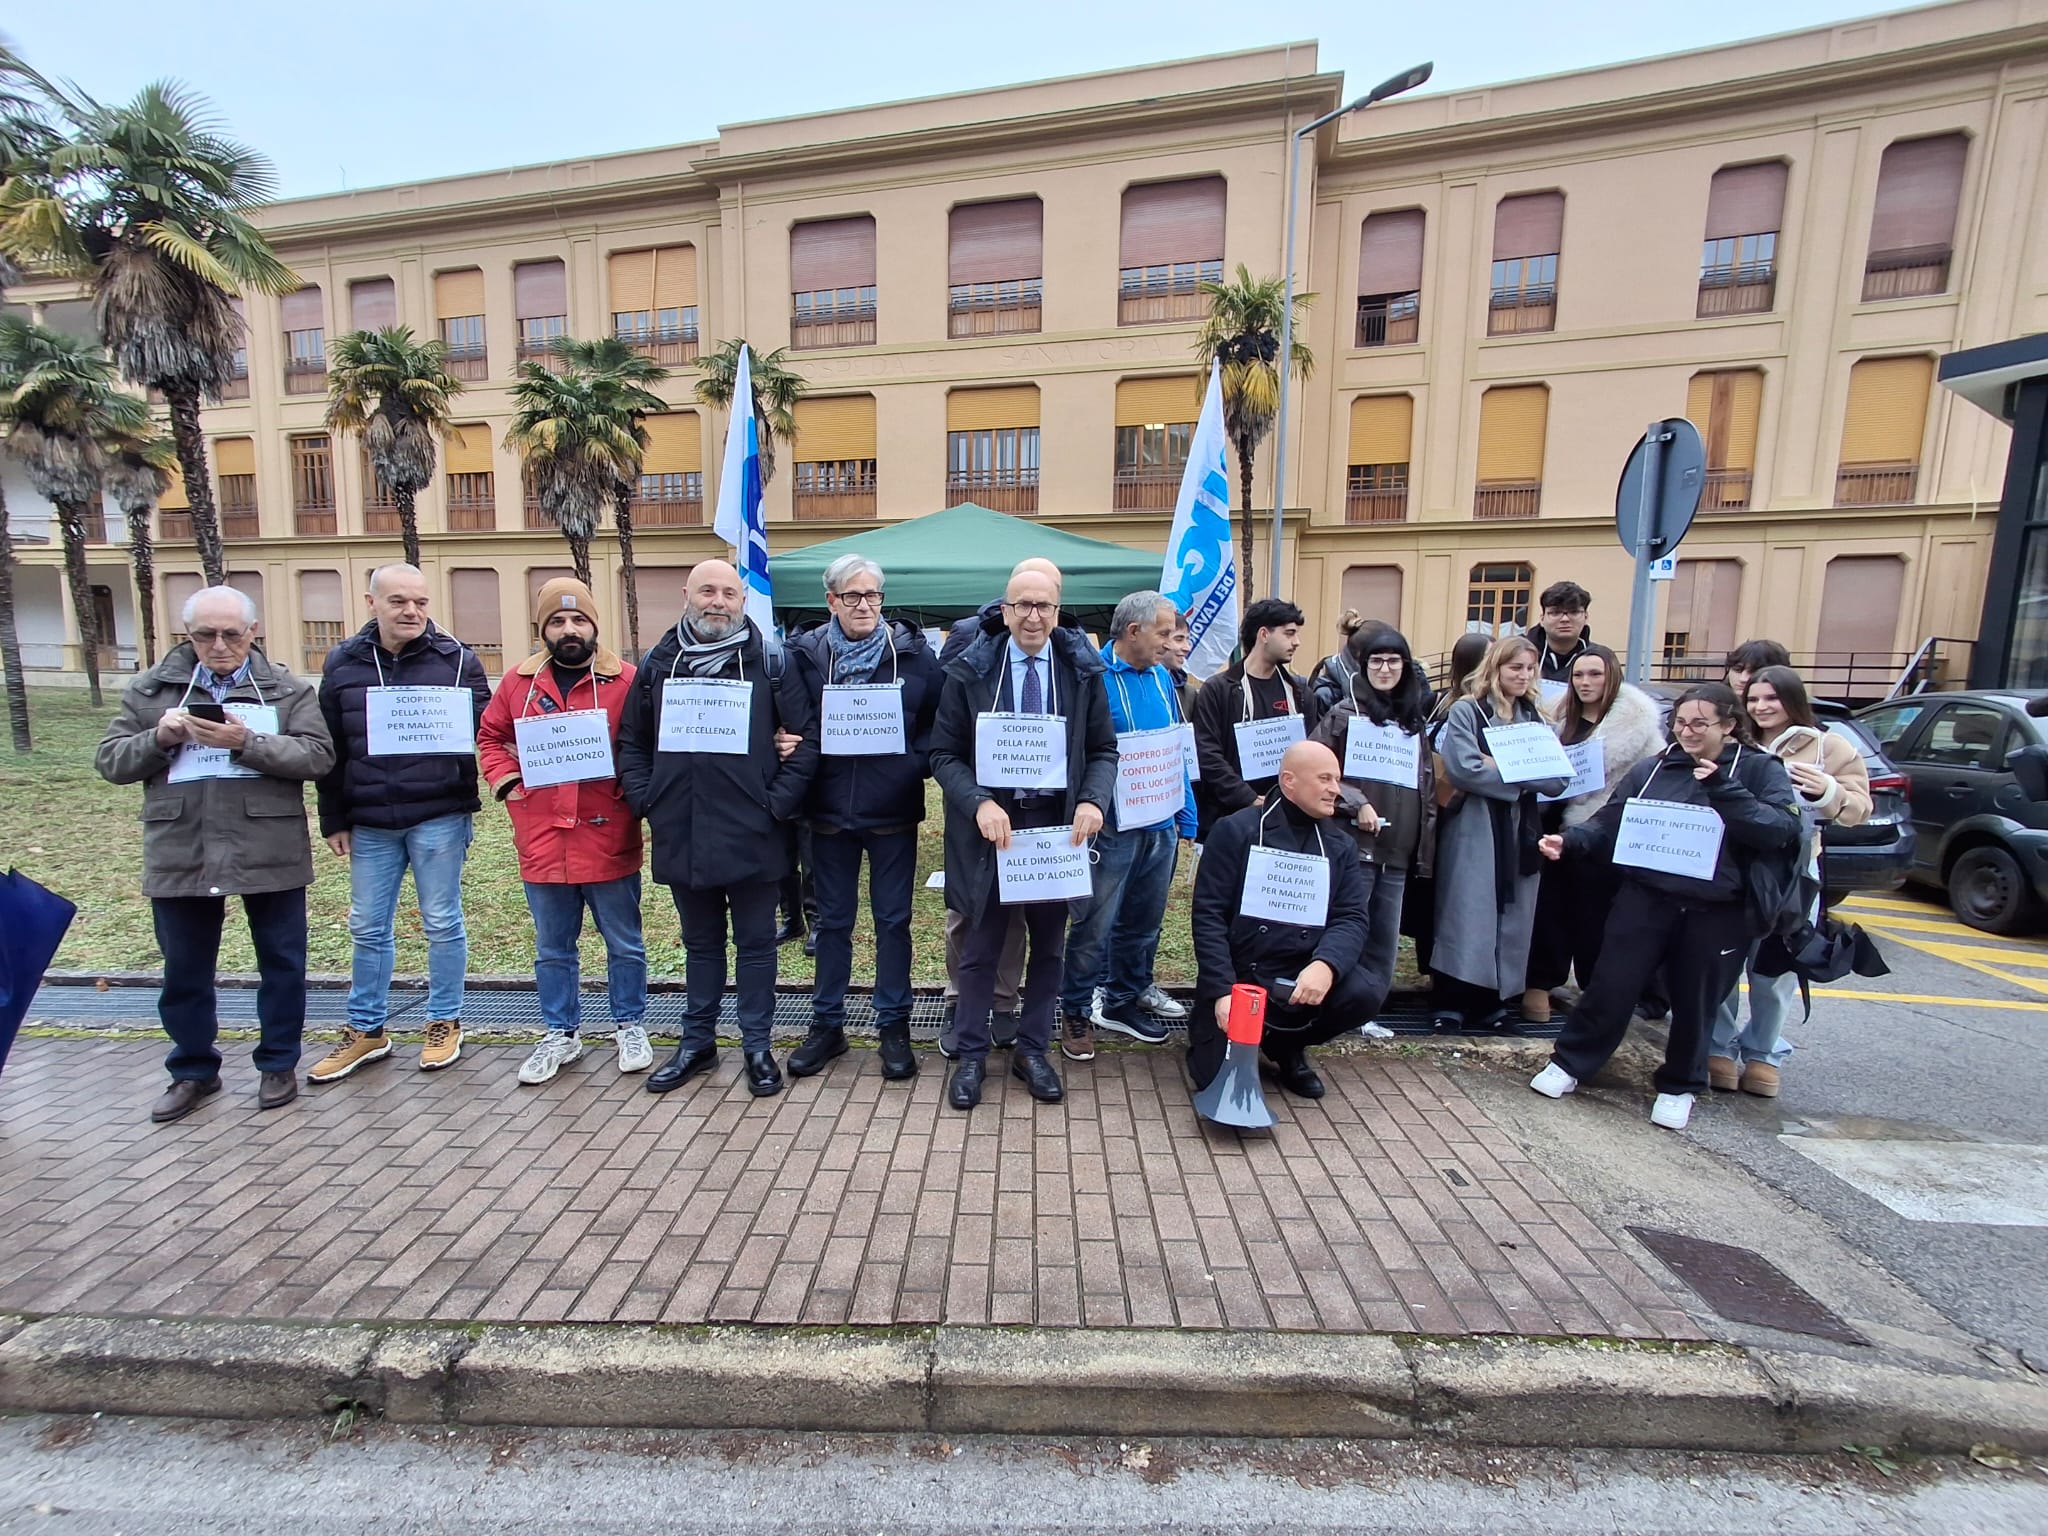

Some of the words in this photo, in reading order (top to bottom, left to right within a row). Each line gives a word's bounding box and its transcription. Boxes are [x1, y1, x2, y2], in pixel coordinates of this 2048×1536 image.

[1001, 337, 1190, 368] SANATORIAL
[666, 698, 702, 706] MALATTIE
[703, 699, 747, 709] INFETTIVE
[853, 698, 868, 706] NO
[391, 709, 419, 717] DELLA
[828, 713, 845, 721] ALLE
[846, 712, 897, 721] DIMISSIONI
[551, 725, 567, 734] NO
[685, 726, 737, 736] ECCELLENZA
[827, 728, 851, 736] DELLA
[1002, 725, 1044, 734] SCIOPERO
[398, 734, 445, 742] INFETTIVE
[1382, 731, 1394, 739] NO
[526, 743, 545, 753] ALLE
[547, 736, 602, 750] DIMISSIONI
[997, 739, 1022, 747] DELLA
[1025, 740, 1048, 748] FAME
[1253, 739, 1273, 747] DELLA
[1354, 740, 1373, 748] ALLE
[1375, 743, 1413, 756] DIMISSIONI
[1120, 749, 1161, 762] SCIOPERO
[1265, 747, 1289, 756] MALAT
[197, 755, 226, 764] INFET
[527, 756, 554, 768] DELLA
[992, 753, 1008, 761] PER
[1010, 754, 1052, 762] MALATTIE
[1352, 753, 1377, 762] DELLA
[1261, 758, 1281, 768] INFETT
[1001, 767, 1043, 775] INFETTIVE
[1122, 765, 1158, 777] CONTRO
[1130, 781, 1147, 791] DEL
[1149, 779, 1164, 789] UOC
[1125, 792, 1165, 807] INFETTIVE
[1625, 816, 1667, 827] MALATTIE
[1669, 821, 1718, 834] INFETTIVE
[1036, 841, 1052, 849] NO
[1645, 844, 1702, 858] ECCELLENZA
[1006, 857, 1029, 867] ALLE
[1030, 853, 1081, 866] DIMISSIONI
[1274, 861, 1313, 873] SCIOPERO
[1006, 872, 1035, 882] DELLA
[1267, 873, 1292, 884] DELLA
[1294, 878, 1316, 887] FAME
[1261, 886, 1277, 895] PER
[1278, 889, 1316, 900] MALATTIE
[1268, 900, 1308, 912] INFETTIVE
